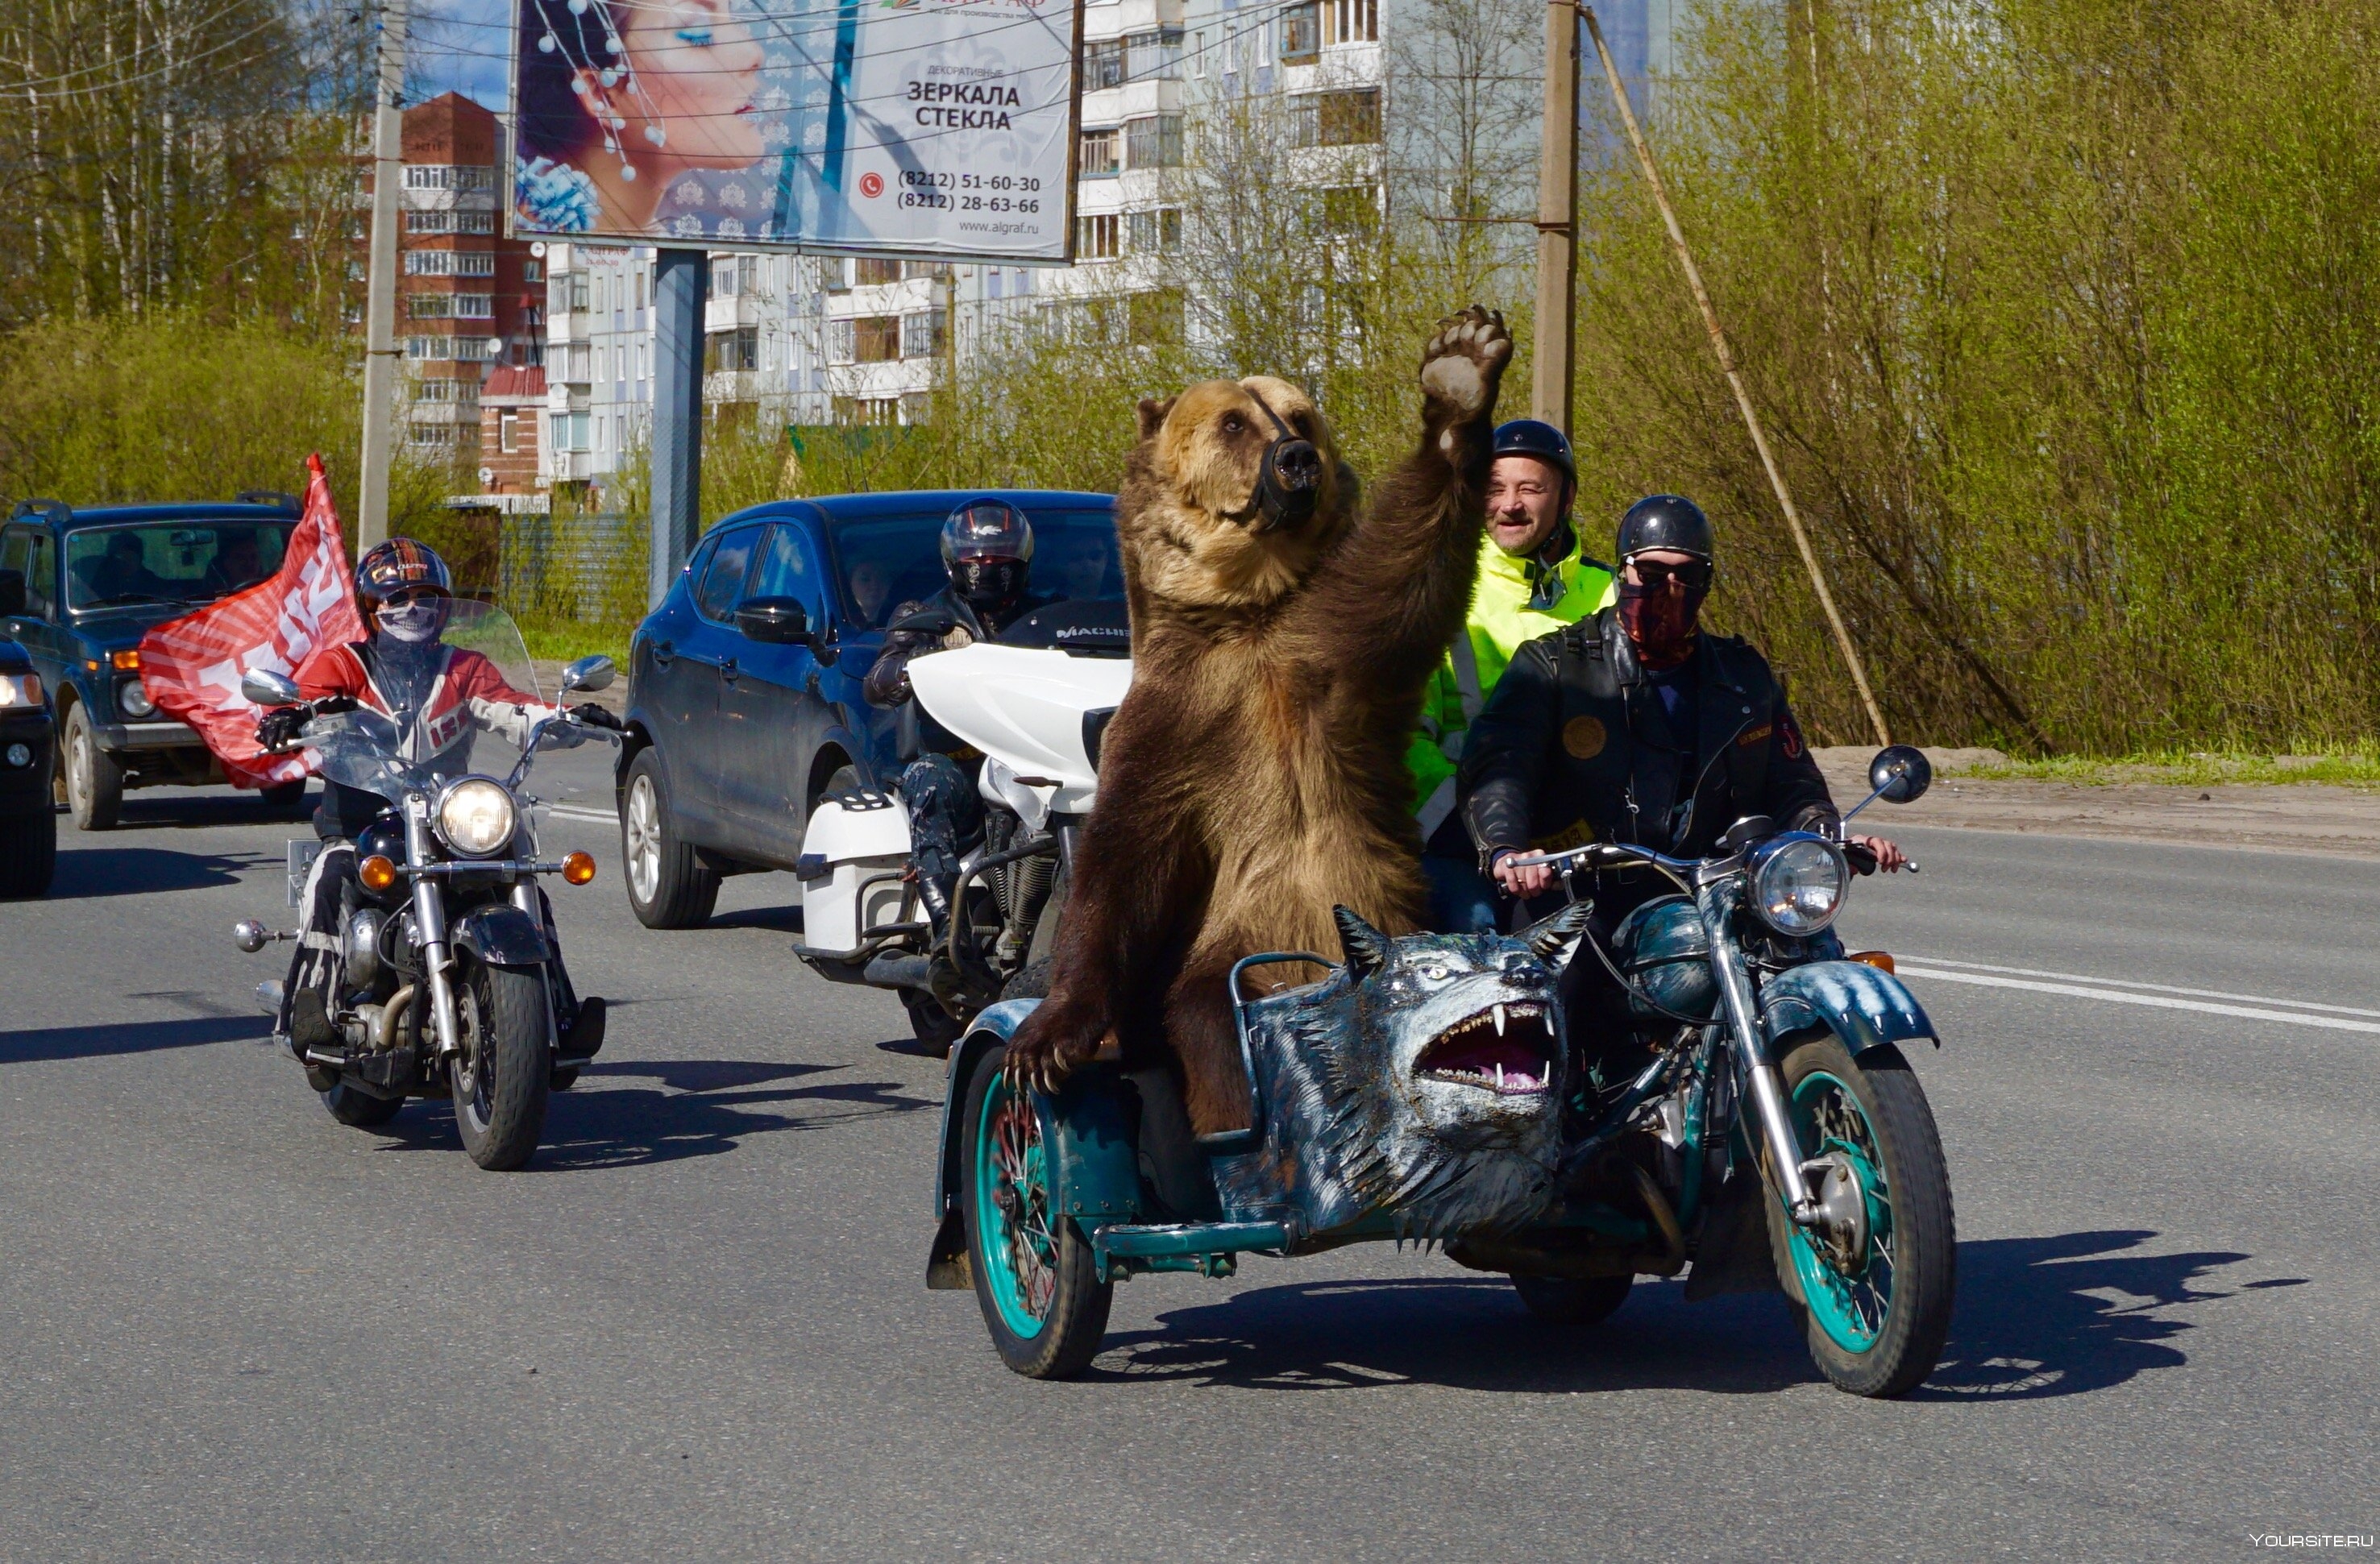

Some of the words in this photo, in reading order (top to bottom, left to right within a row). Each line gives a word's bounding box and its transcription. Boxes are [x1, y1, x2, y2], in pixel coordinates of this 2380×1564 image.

[928, 64, 1003, 77] ДЕКОРАТИВНЫЕ
[907, 81, 1020, 106] ЗЕРКАЛА
[916, 106, 1011, 131] СТЕКЛА
[898, 170, 956, 190] (8212)
[962, 174, 1040, 192] 51-60-30
[897, 192, 955, 212] (8212)
[961, 196, 1039, 214] 28-63-66
[959, 221, 1039, 235] www.algraf.ru
